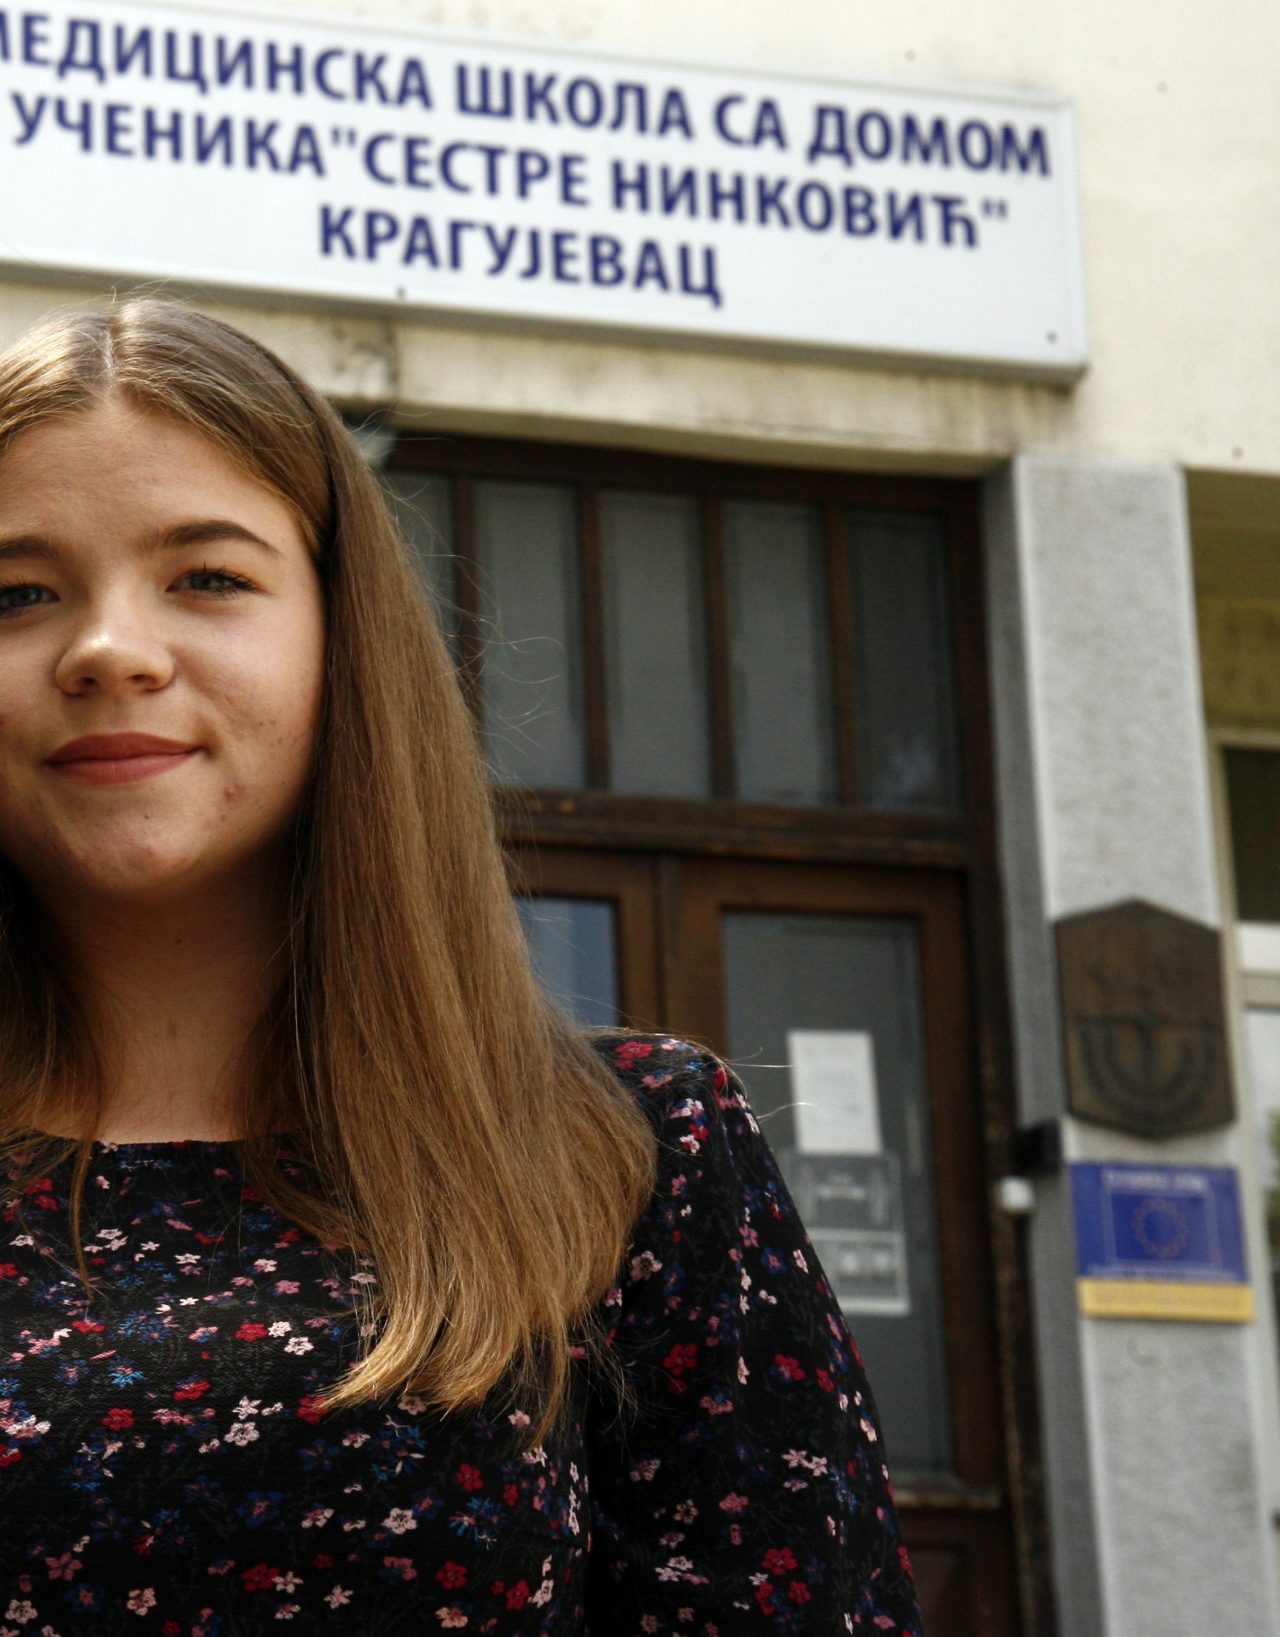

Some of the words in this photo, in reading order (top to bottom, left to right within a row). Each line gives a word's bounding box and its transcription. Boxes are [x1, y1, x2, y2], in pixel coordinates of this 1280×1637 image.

[454, 62, 696, 141] ШКОЛА
[711, 93, 789, 152] СА
[805, 103, 1052, 179] ДОМОМ
[318, 203, 725, 310] КРАГУЈЕВАЦ
